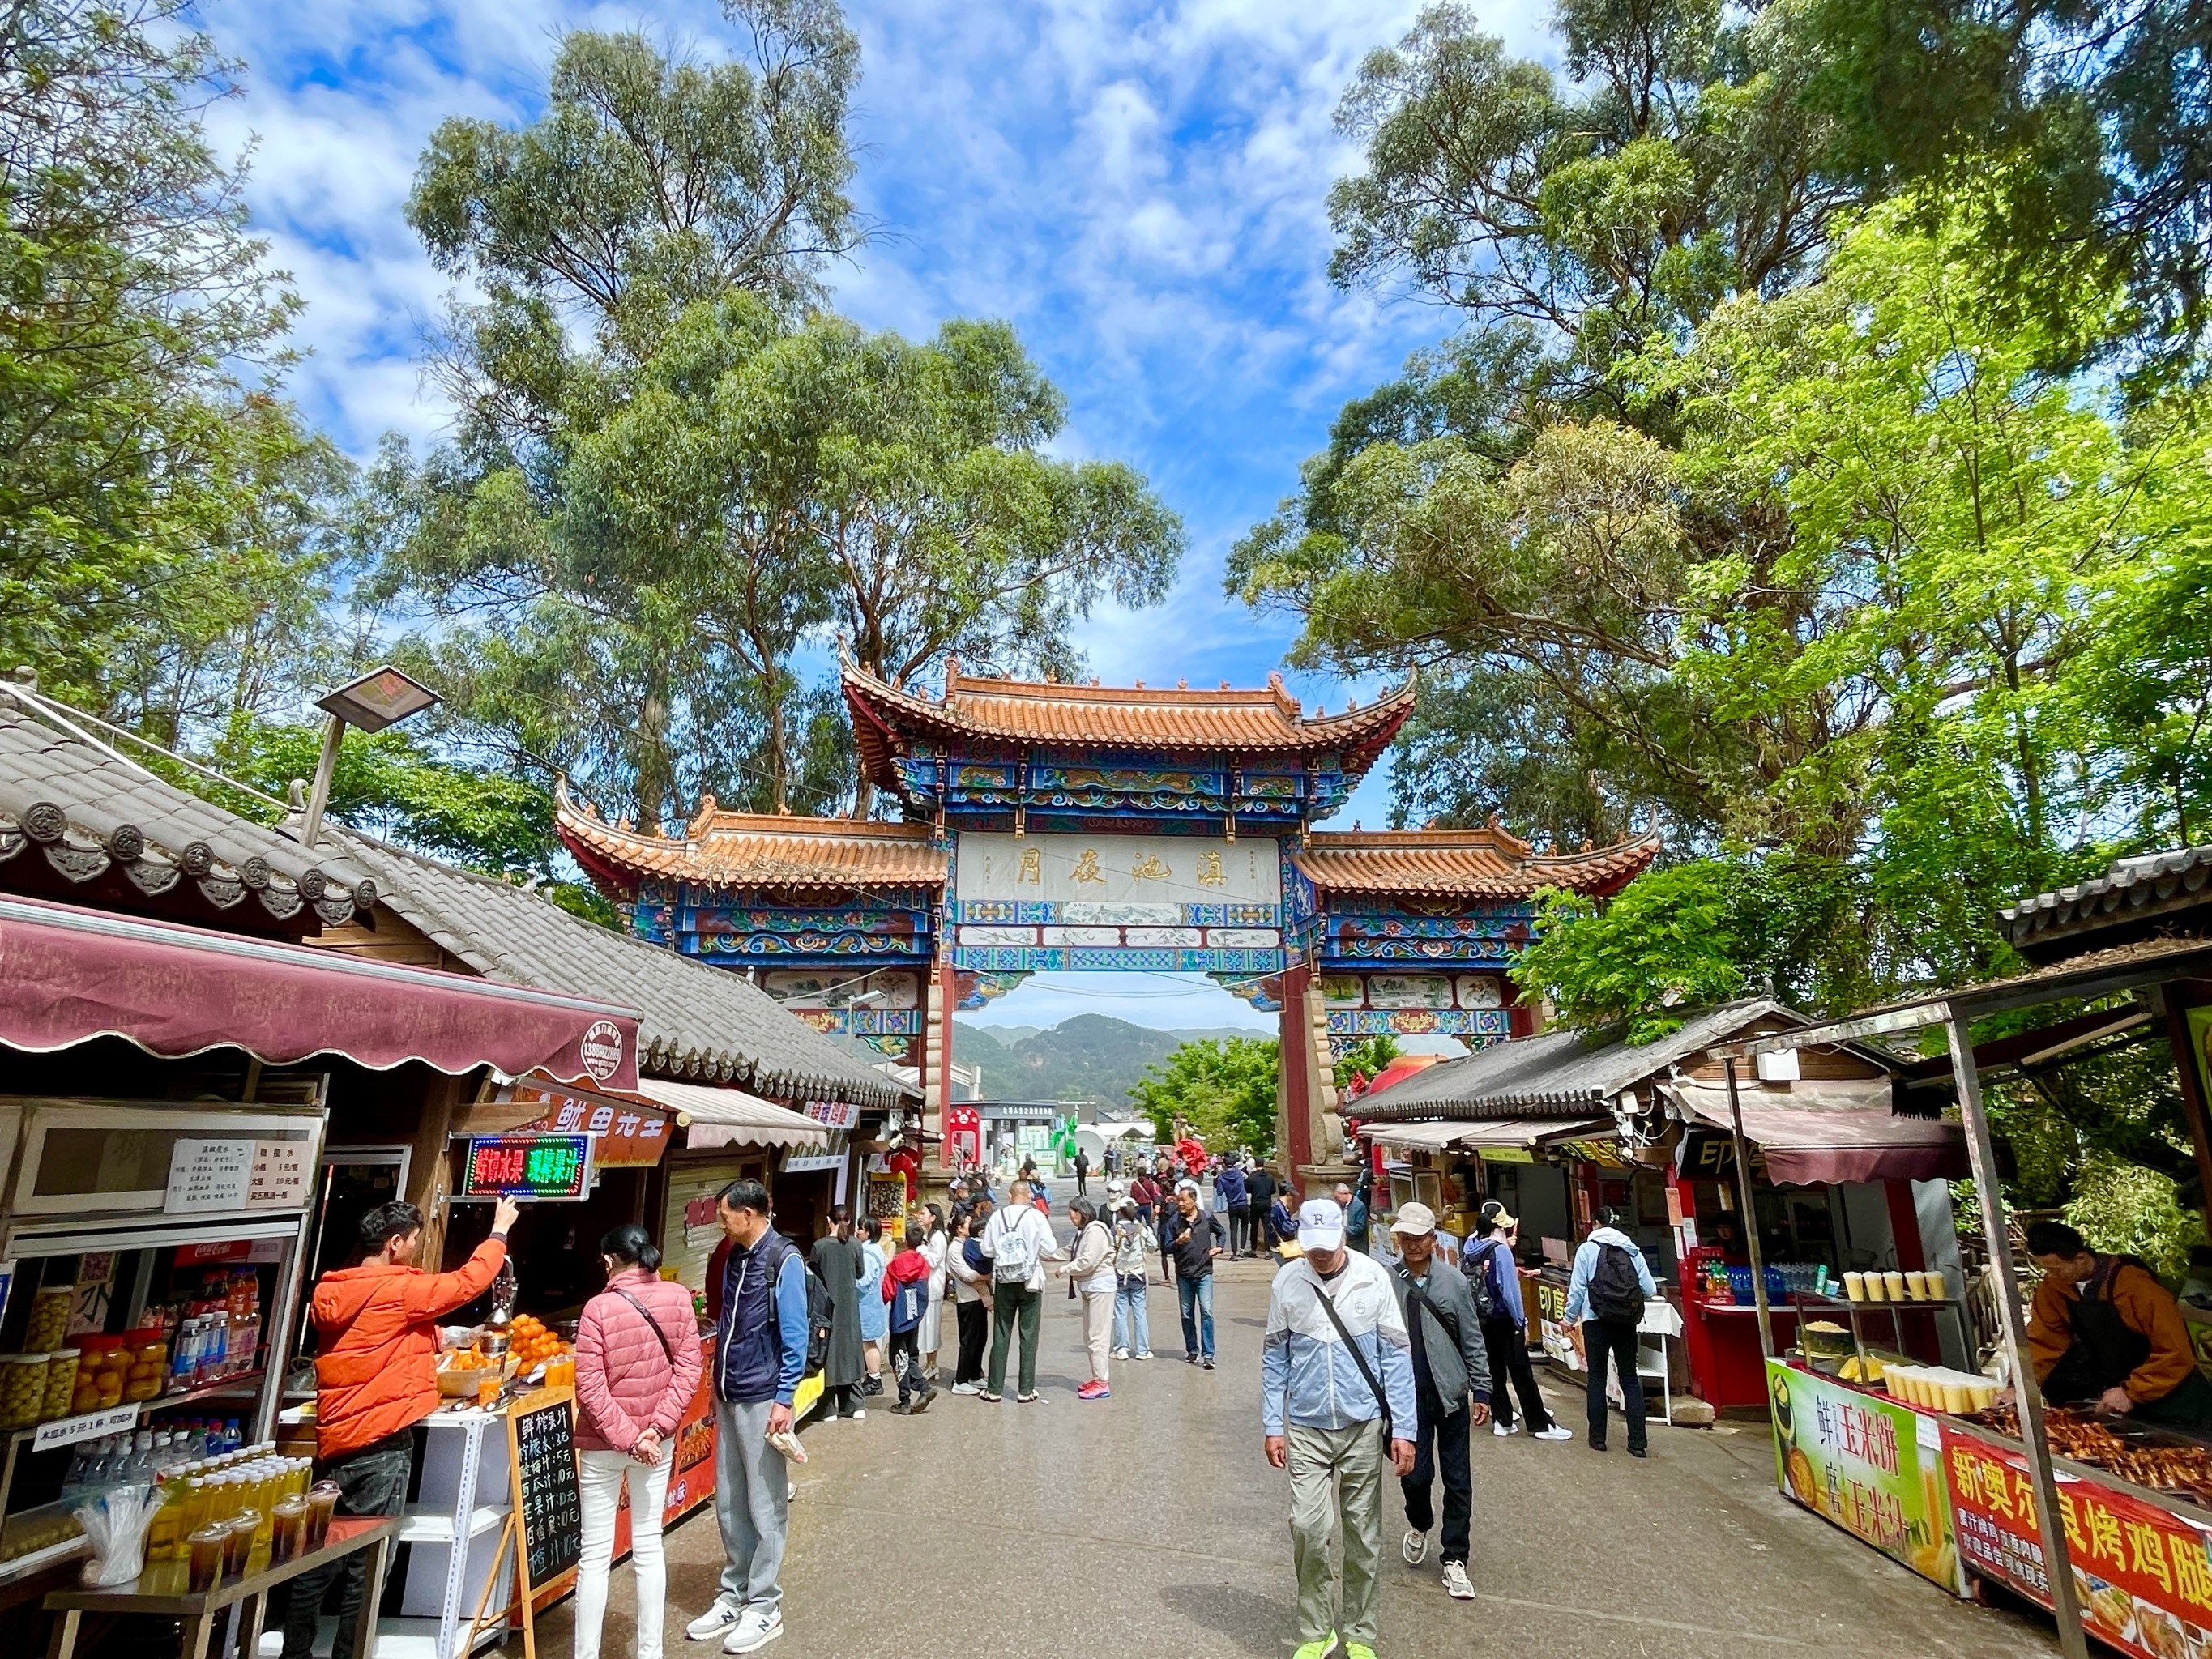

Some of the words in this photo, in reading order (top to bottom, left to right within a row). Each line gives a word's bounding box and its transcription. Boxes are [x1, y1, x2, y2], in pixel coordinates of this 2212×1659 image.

[553, 1098, 665, 1137] 鱿鱼先生
[1313, 1213, 1326, 1225] R
[522, 1406, 567, 1441] 鲜榨果汁
[1837, 1401, 1900, 1478] 玉米饼
[1847, 1478, 1910, 1550] 玉米汁
[1962, 1532, 2004, 1567] 欢迎品尝
